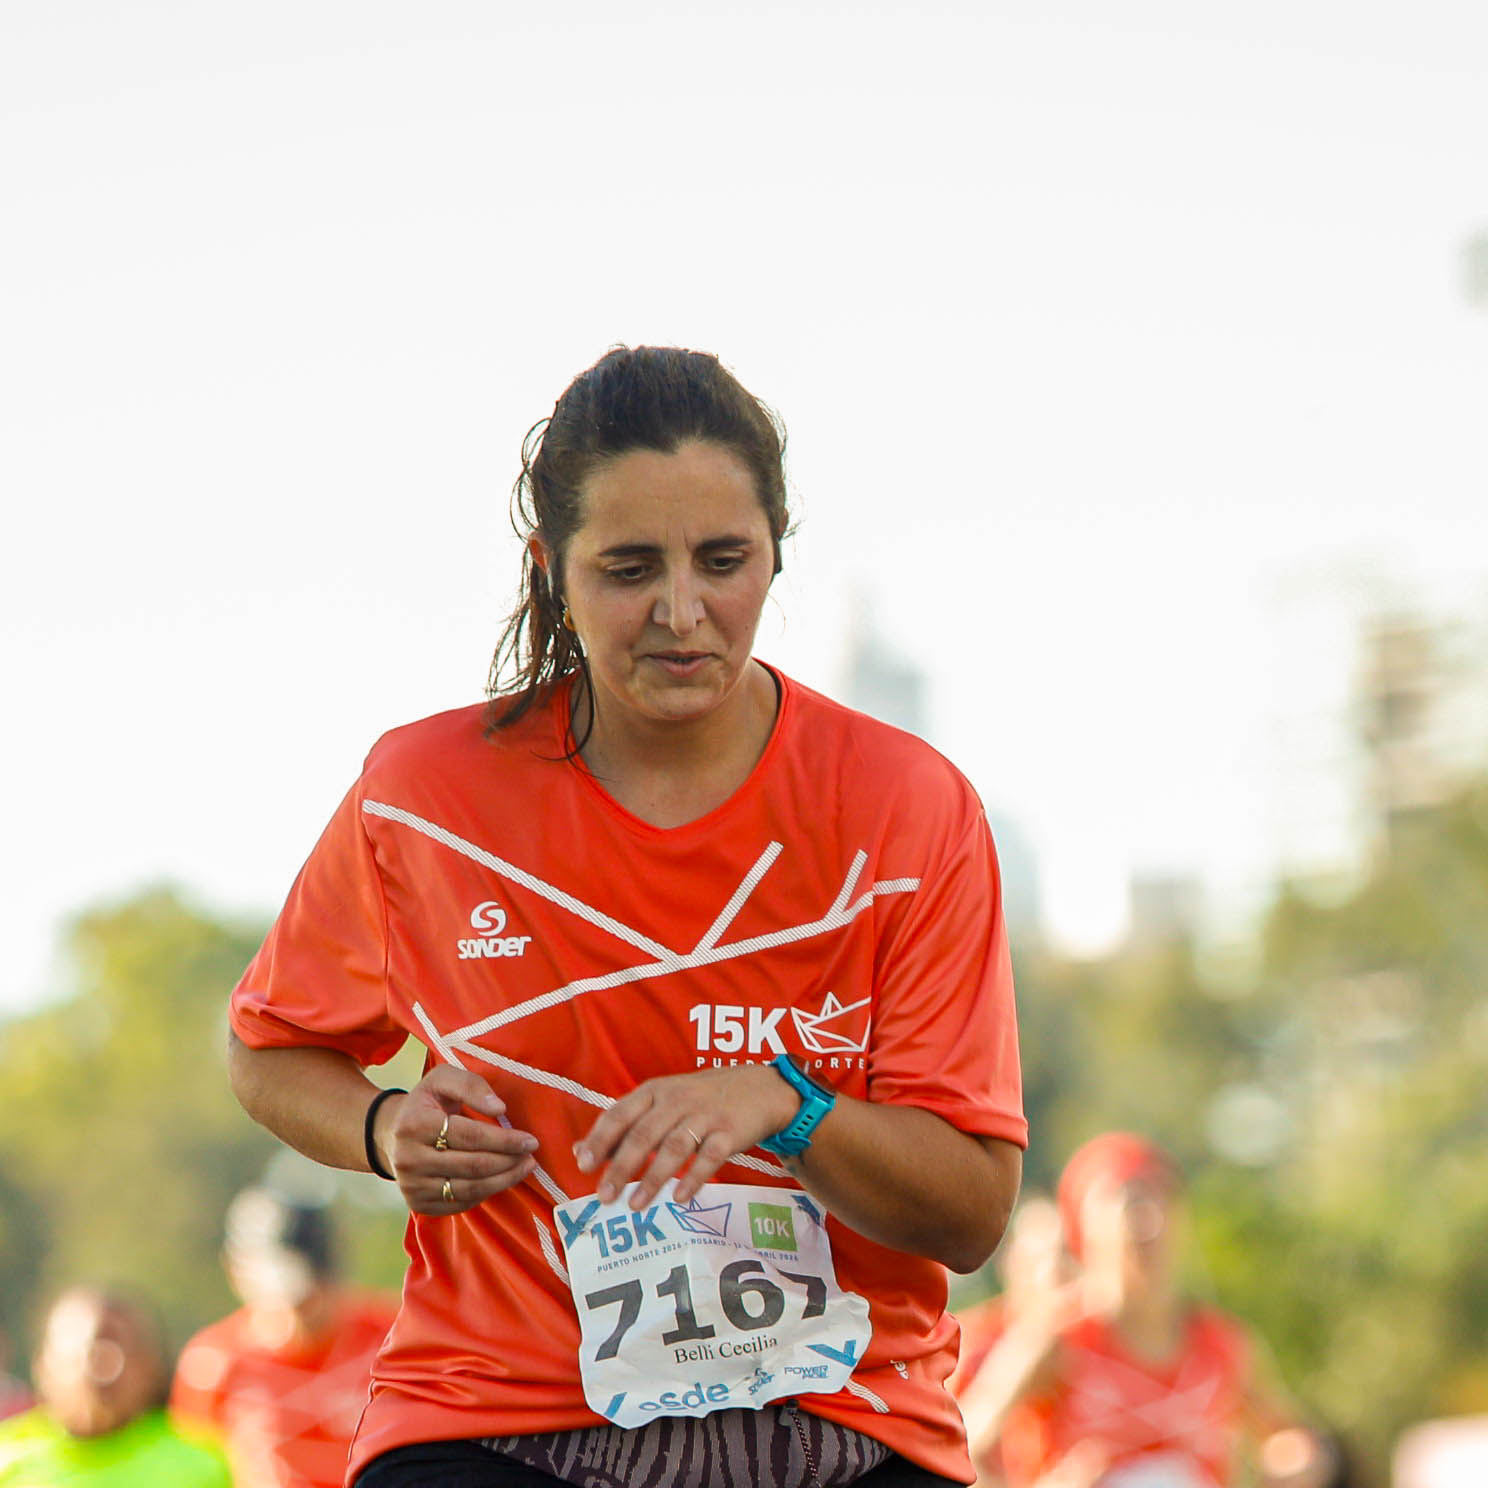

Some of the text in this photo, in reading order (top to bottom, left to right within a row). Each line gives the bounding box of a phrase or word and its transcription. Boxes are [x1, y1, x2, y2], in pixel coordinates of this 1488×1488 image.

[689, 1003, 789, 1055] 15K
[803, 1057, 866, 1070] ORTE
[590, 1204, 667, 1258] 15K
[754, 1216, 791, 1238] 10K
[597, 1257, 631, 1272] PUERTO
[632, 1249, 661, 1262] NORTE
[690, 1237, 727, 1247] ROSARIO
[674, 1335, 779, 1364] Belli Cecilia
[639, 1381, 731, 1411] osde
